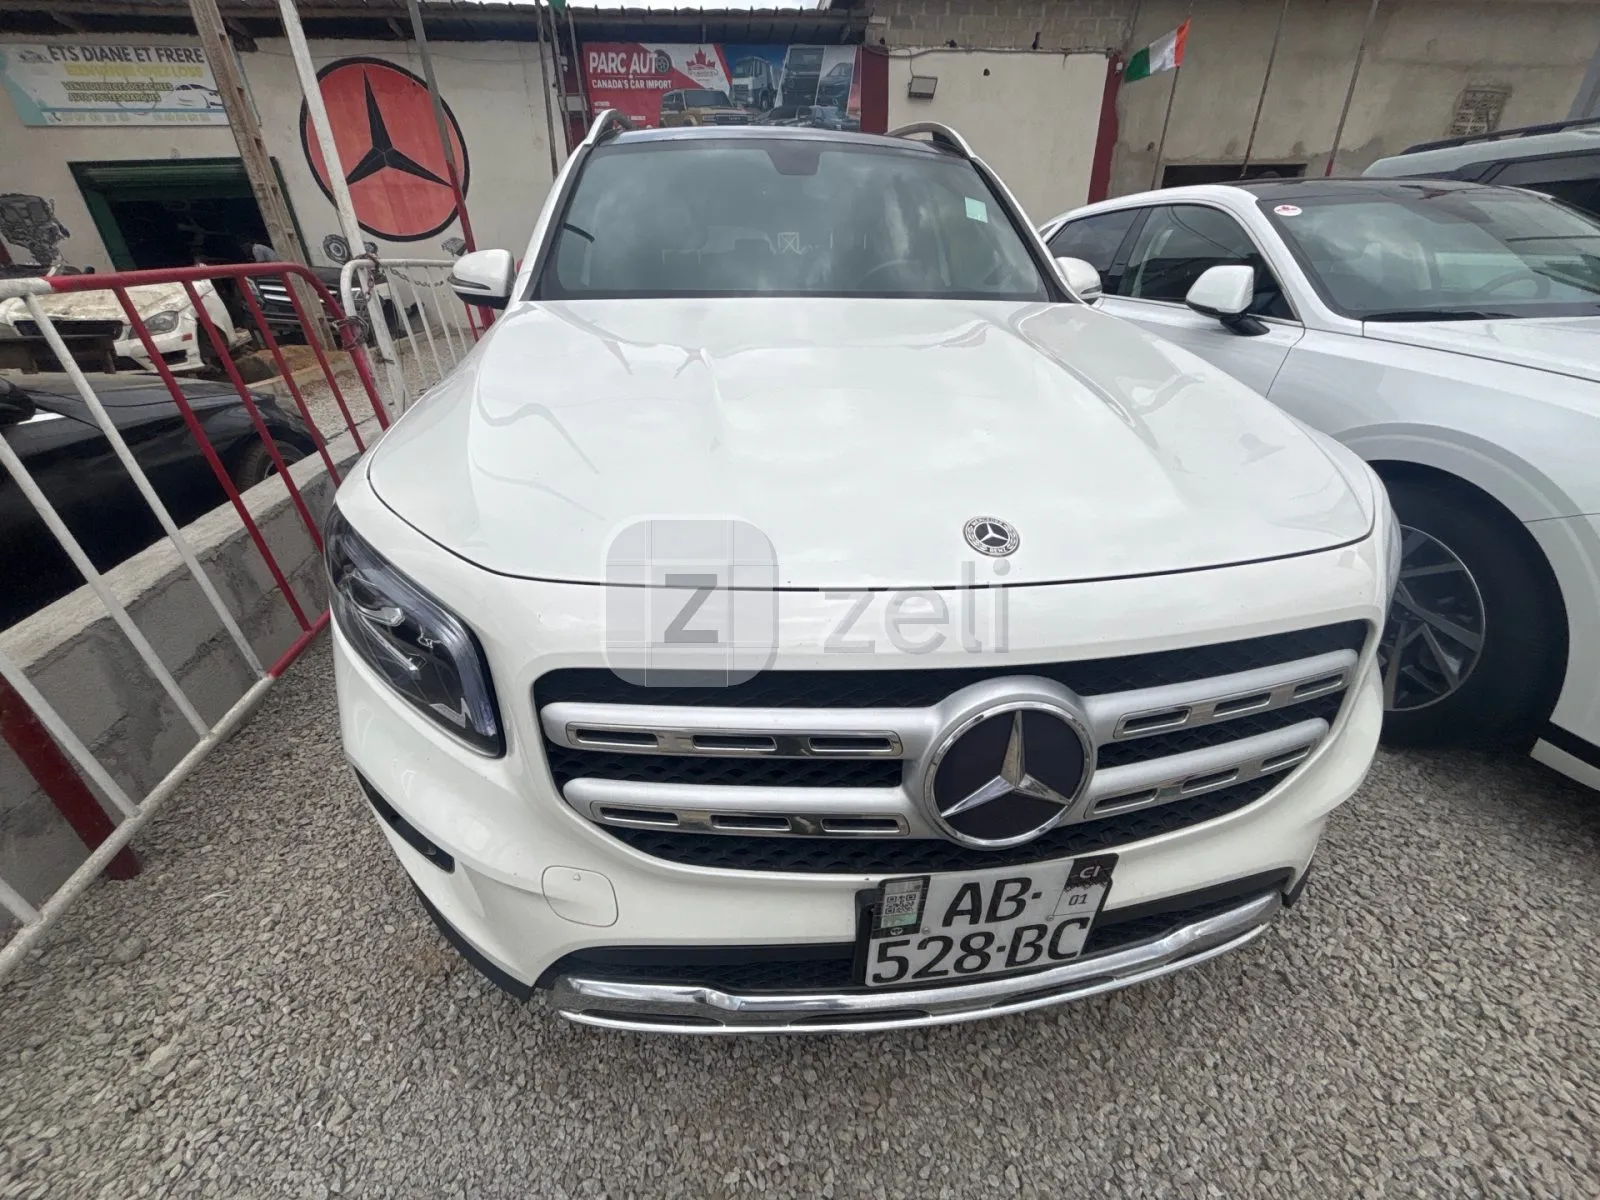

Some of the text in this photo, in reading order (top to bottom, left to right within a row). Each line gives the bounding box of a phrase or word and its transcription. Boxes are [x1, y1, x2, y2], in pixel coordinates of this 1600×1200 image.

[48, 45, 205, 63] ETS DIANE ET FRERE
[589, 51, 627, 74] PARC
[592, 79, 672, 89] CANADA'S CAR IMPORT
[1080, 865, 1101, 879] CI
[1068, 893, 1089, 906] 01
